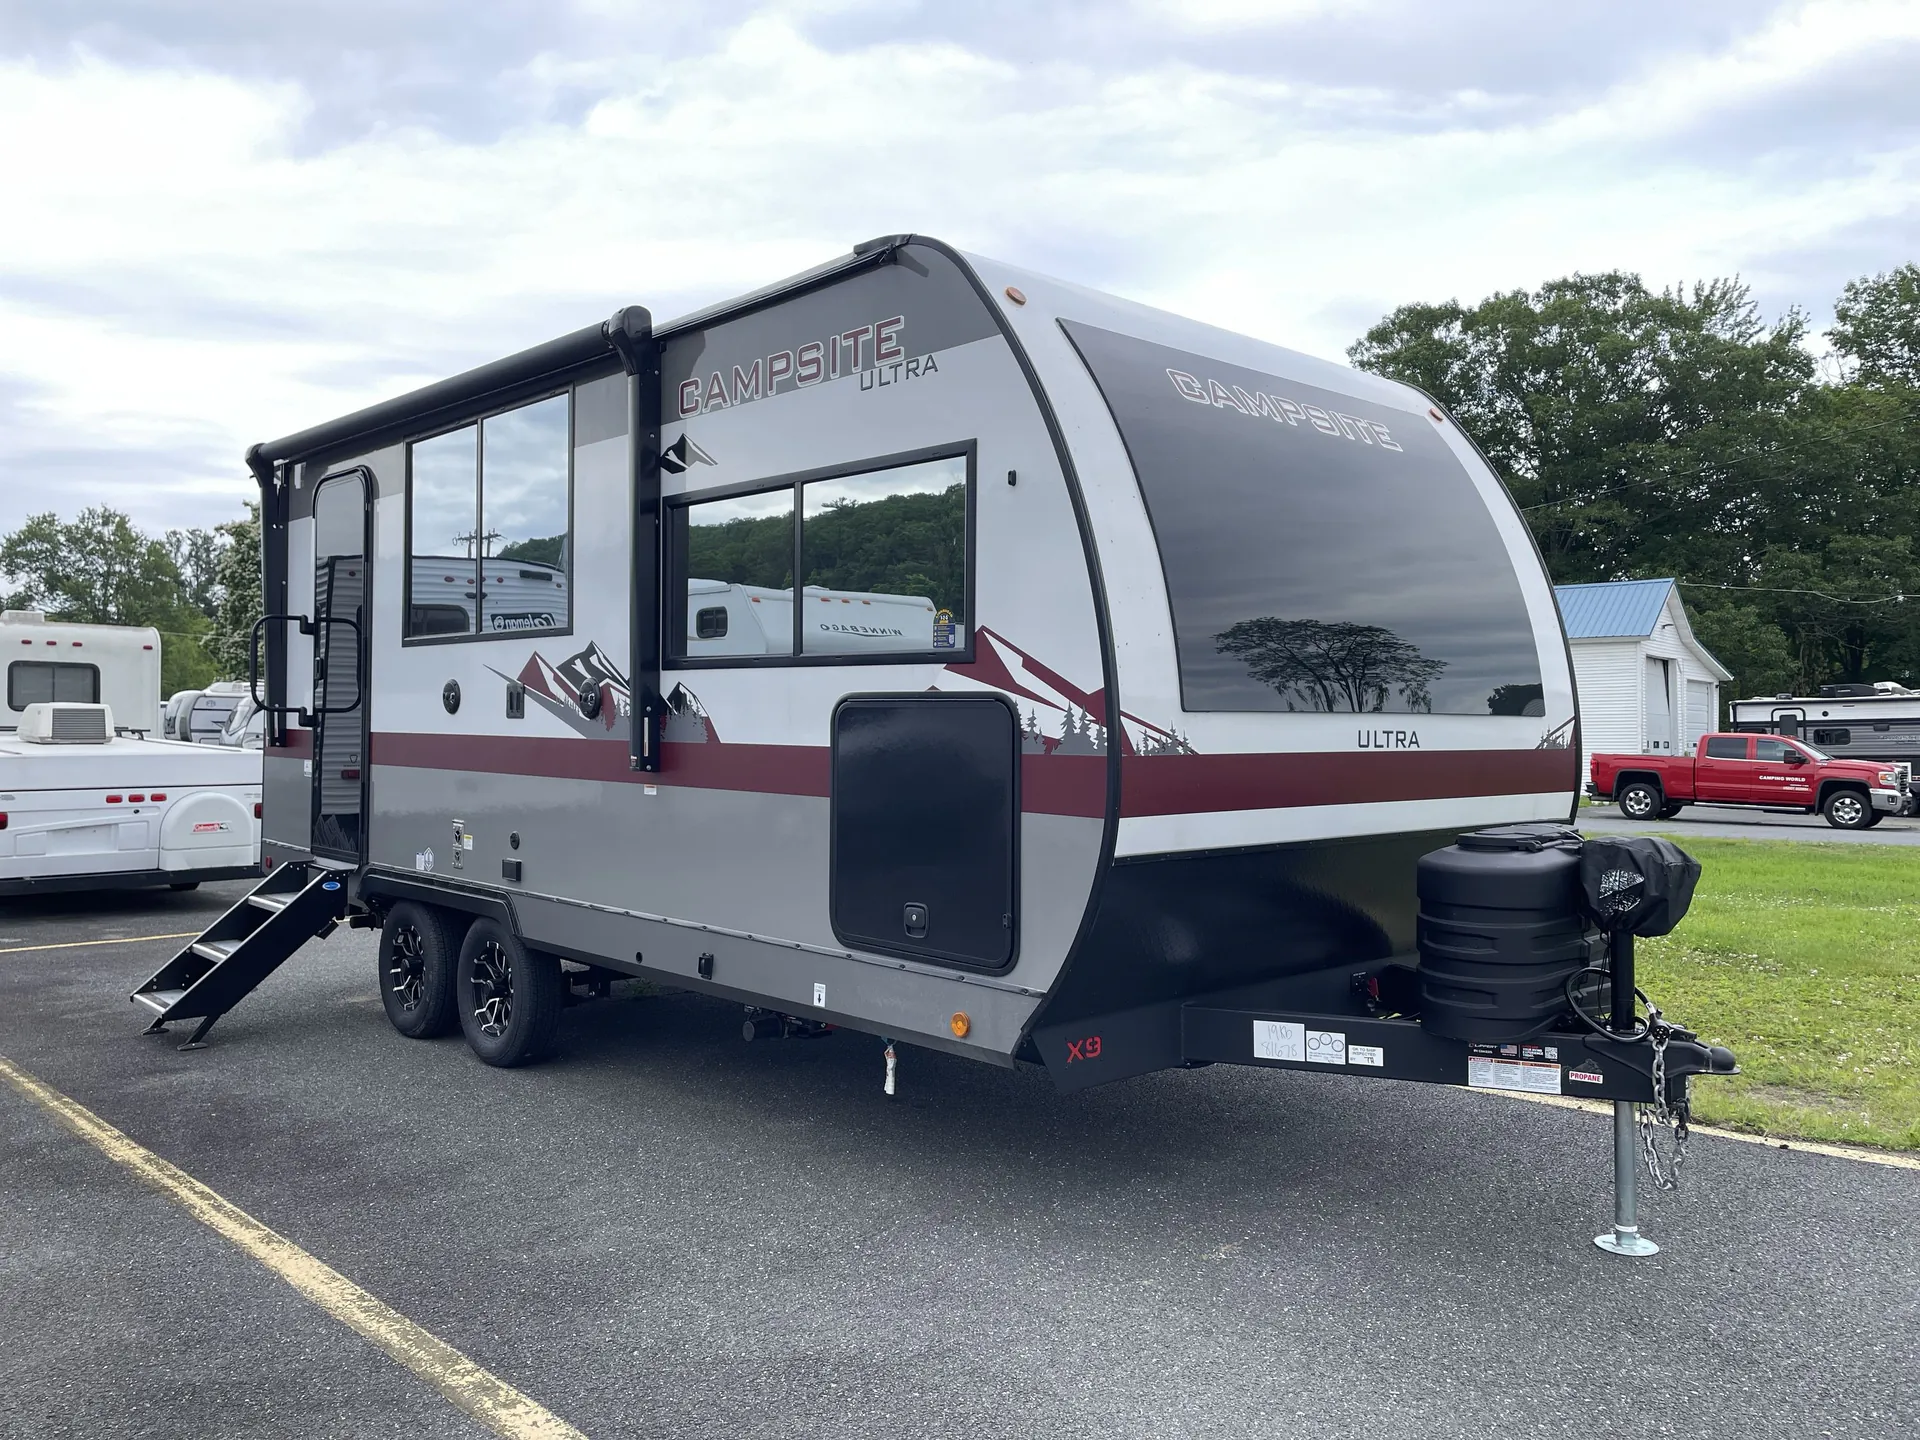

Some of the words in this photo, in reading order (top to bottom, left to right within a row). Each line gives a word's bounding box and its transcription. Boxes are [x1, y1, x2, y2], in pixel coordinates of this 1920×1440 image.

[678, 315, 905, 419] CAMPSITE
[860, 354, 938, 391] ULTRA
[1166, 368, 1404, 452] CAMPSITE
[1358, 730, 1420, 748] ULTRA
[1066, 1036, 1102, 1063] X9
[1570, 1072, 1601, 1082] PROPANE
